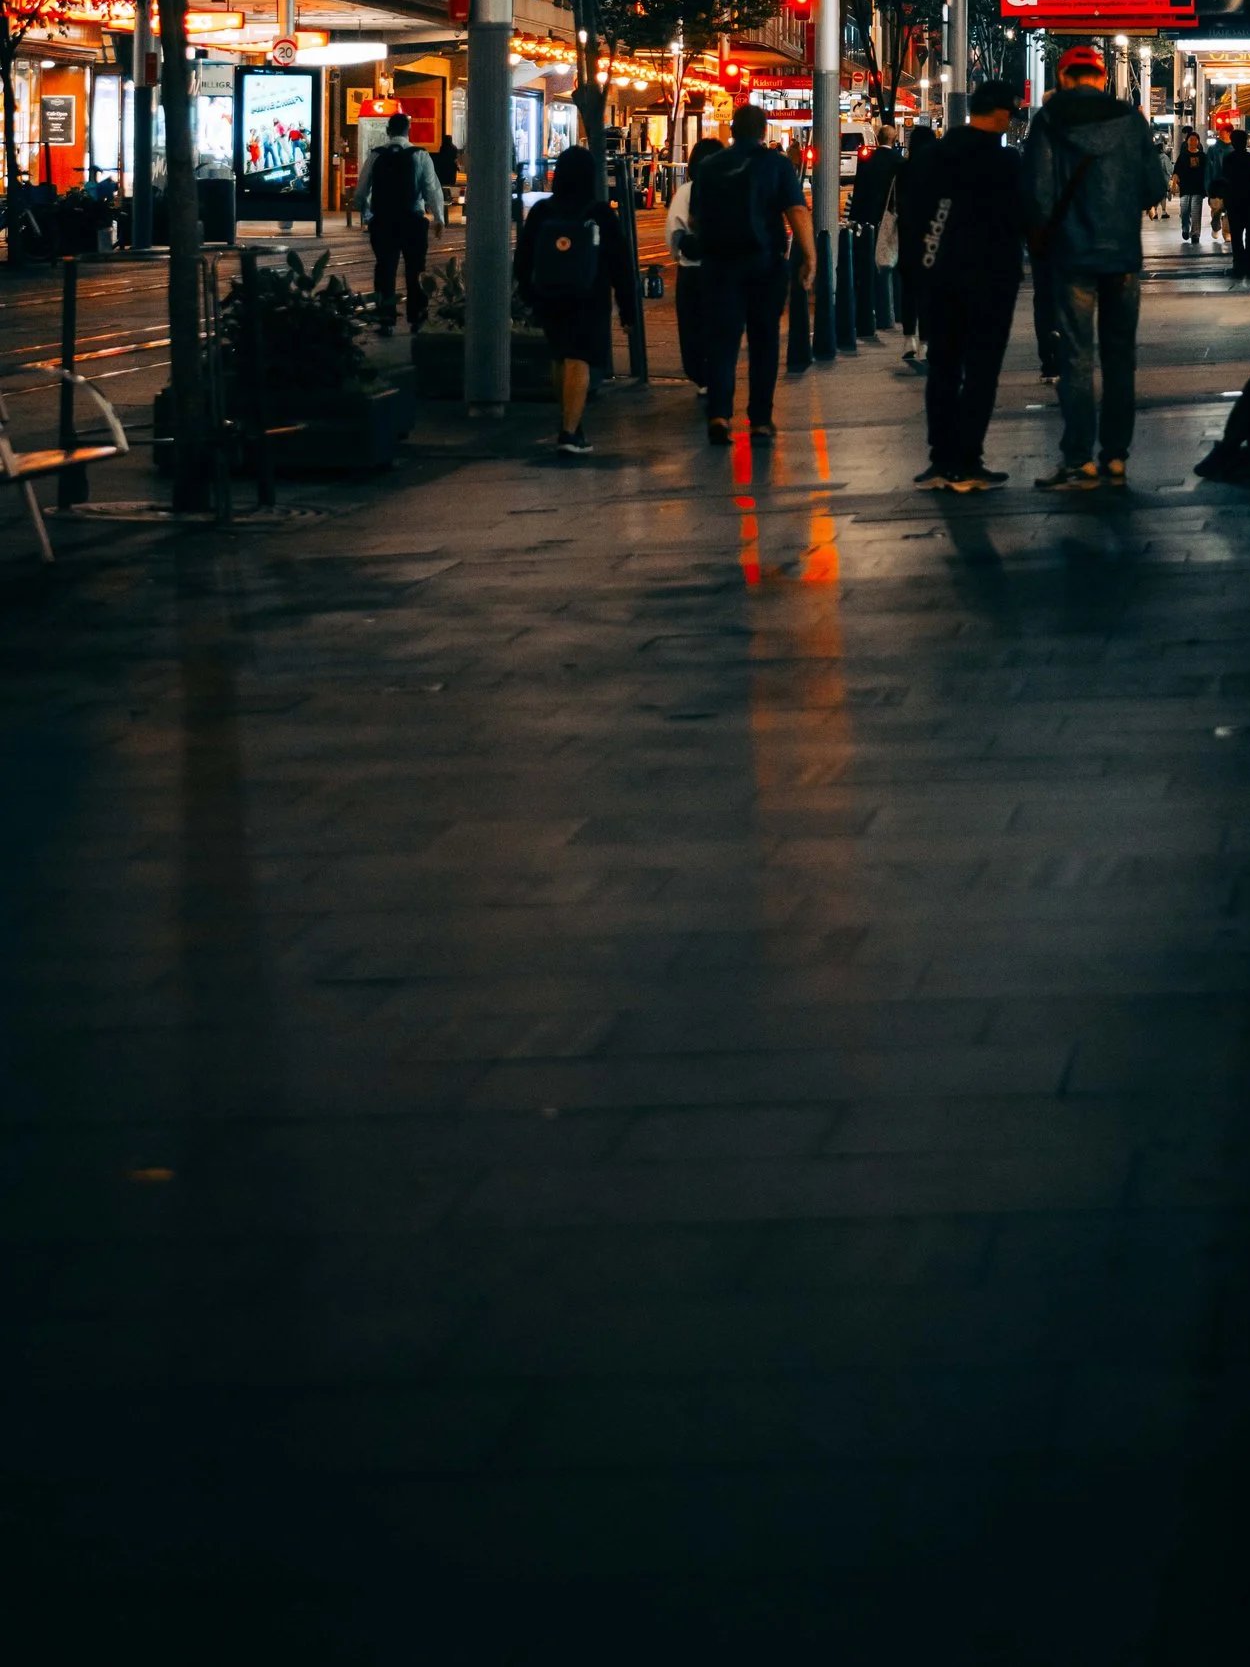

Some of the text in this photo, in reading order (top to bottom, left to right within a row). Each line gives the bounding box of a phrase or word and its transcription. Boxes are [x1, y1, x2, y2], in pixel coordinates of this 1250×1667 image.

[278, 47, 293, 58] 20
[753, 78, 784, 87] Kidstuff
[921, 198, 953, 269] adidas
